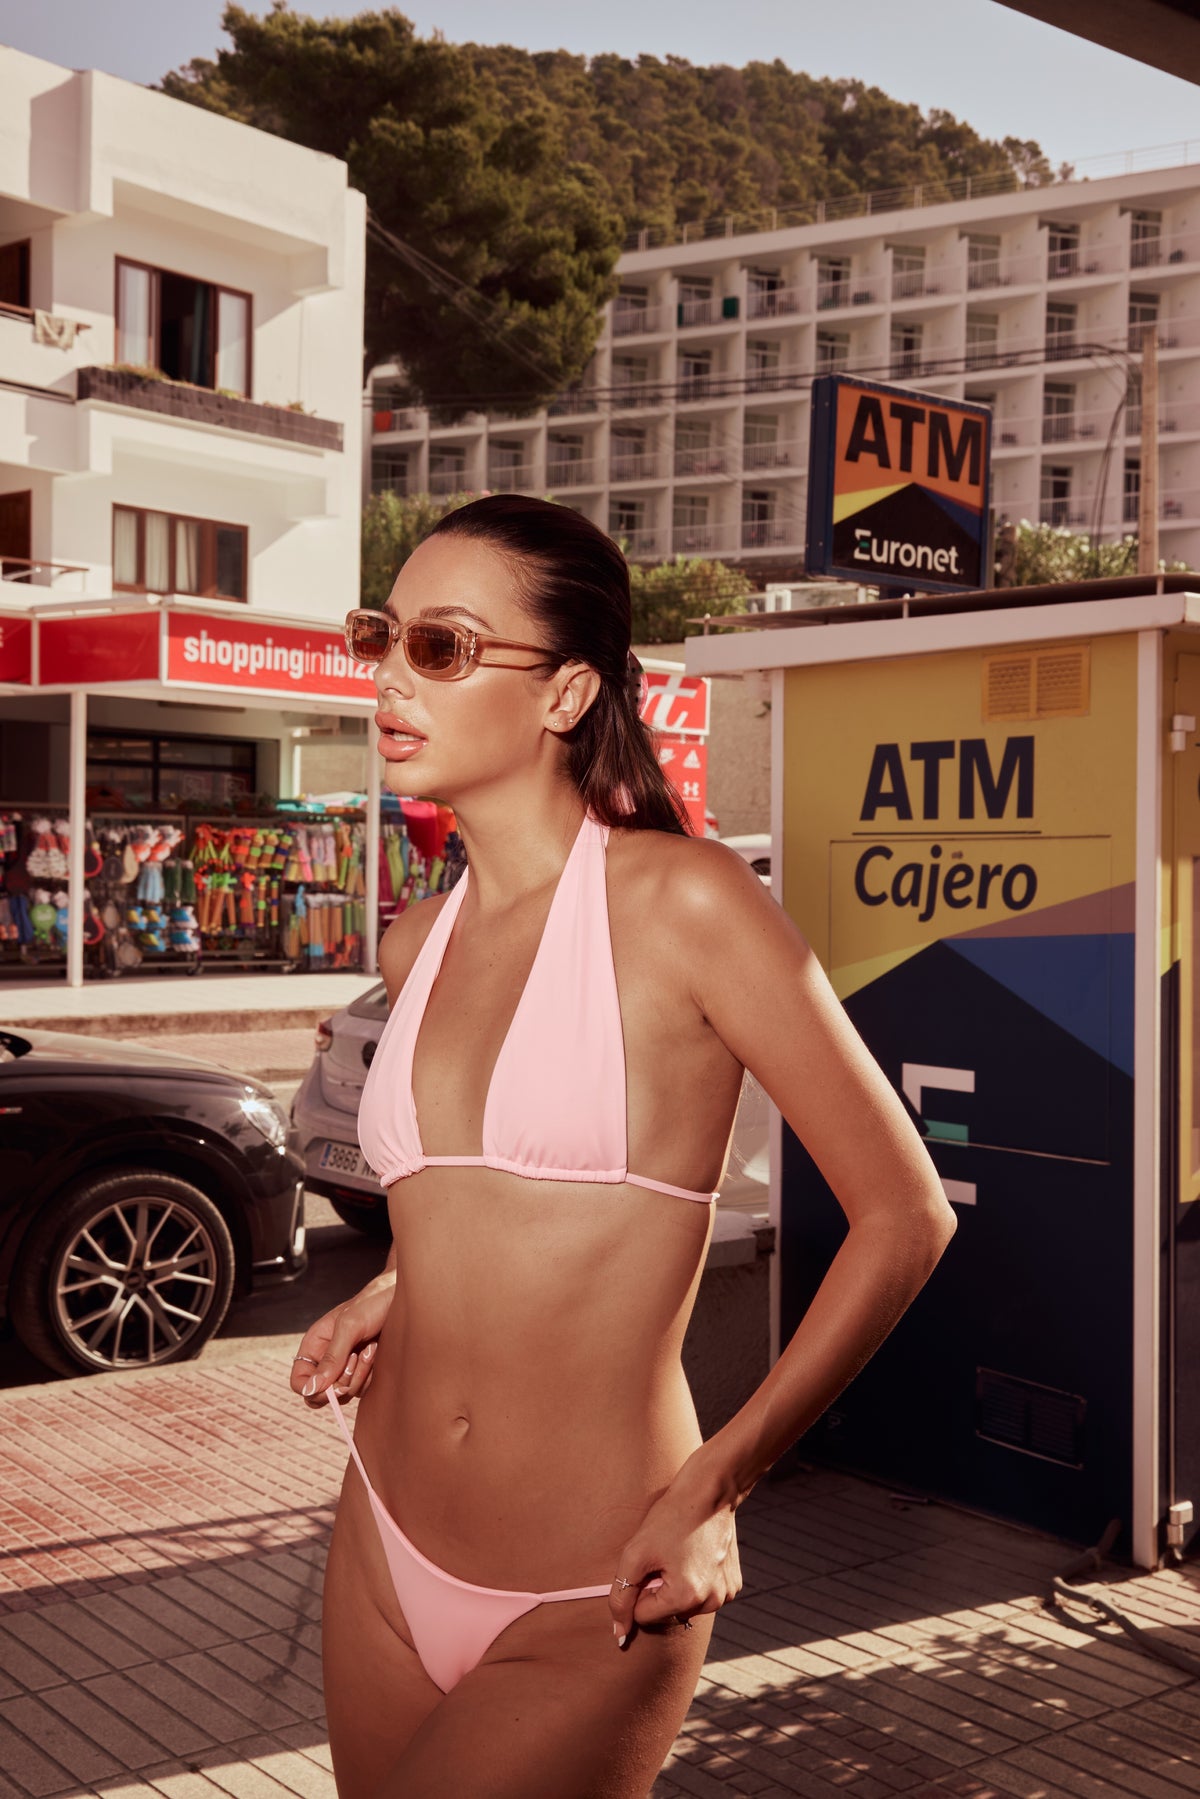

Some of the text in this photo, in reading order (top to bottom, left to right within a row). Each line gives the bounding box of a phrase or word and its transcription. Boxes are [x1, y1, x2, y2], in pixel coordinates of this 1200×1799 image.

[844, 394, 983, 486] ATM
[853, 528, 960, 575] Euronet
[859, 735, 1035, 821] ATM
[854, 844, 1038, 922] Cajero
